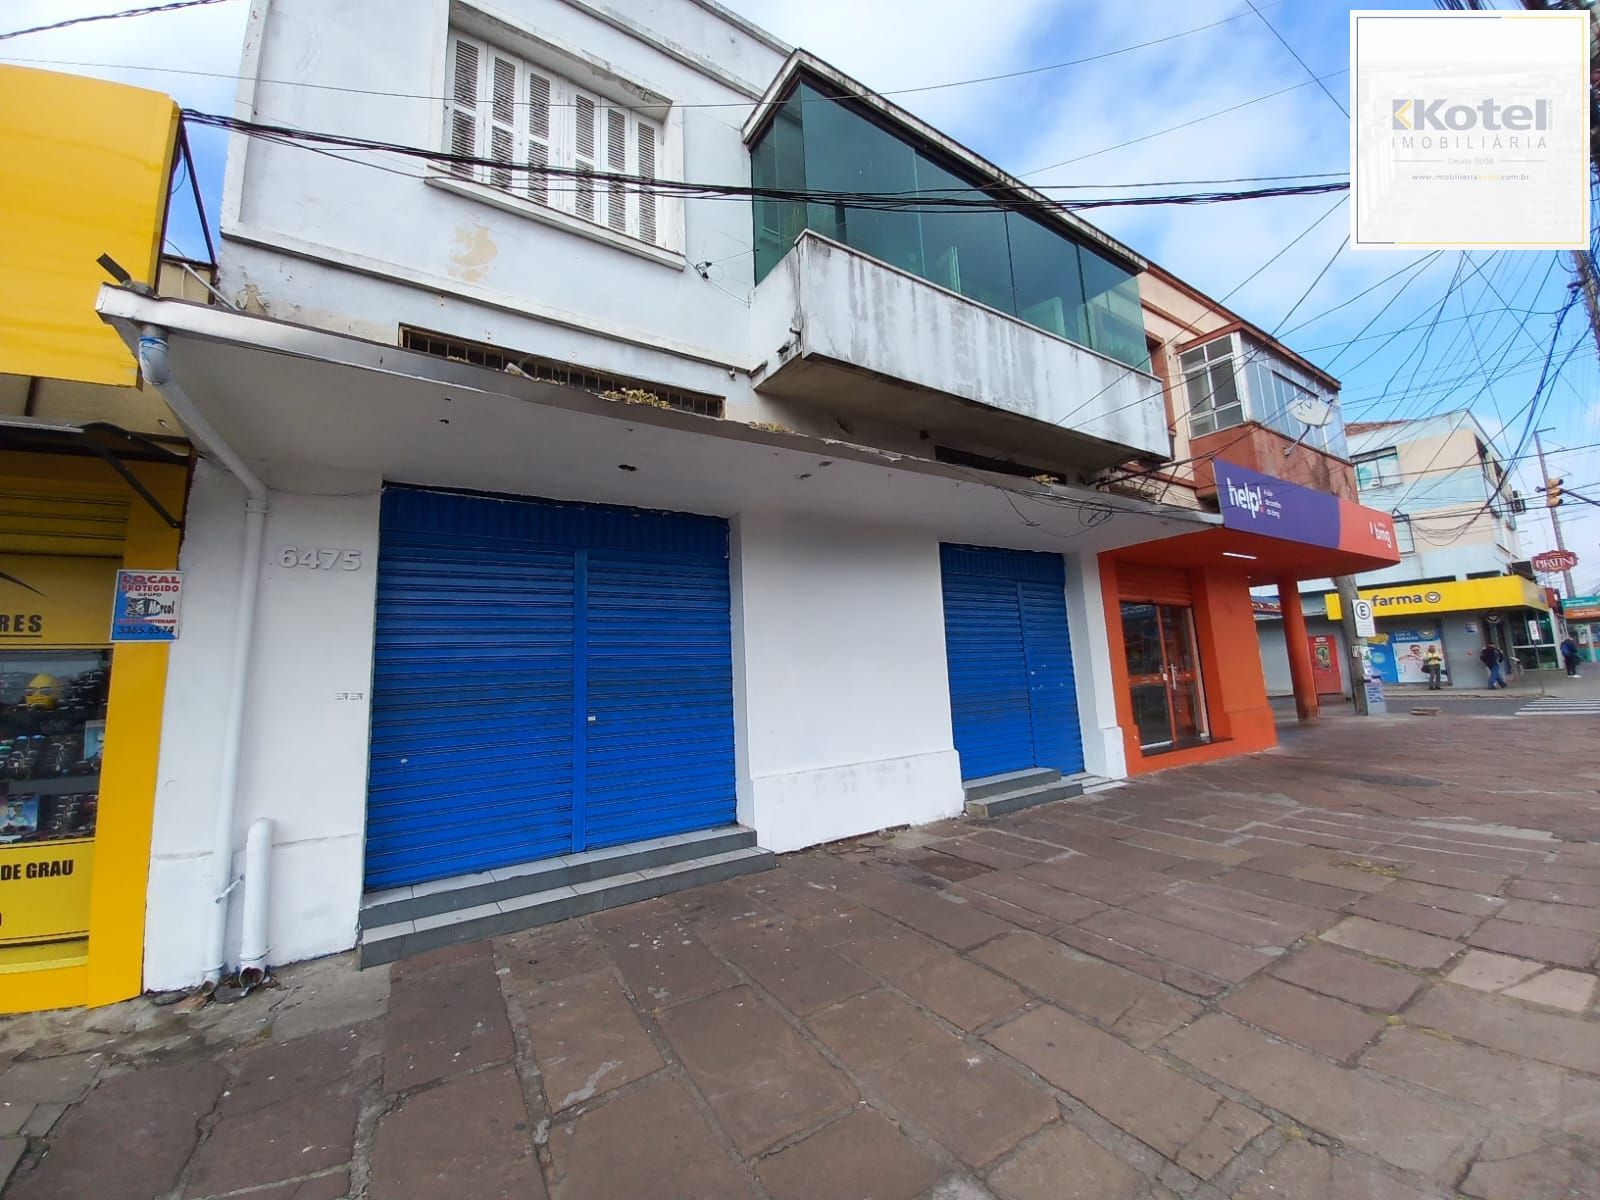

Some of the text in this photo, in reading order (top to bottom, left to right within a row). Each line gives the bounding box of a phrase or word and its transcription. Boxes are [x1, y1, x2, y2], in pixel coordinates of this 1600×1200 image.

[1226, 476, 1265, 519] help!
[277, 546, 362, 572] 6475
[121, 575, 181, 584] LOCAL
[121, 583, 180, 593] PROTEGIDO
[1371, 594, 1423, 607] farma
[1359, 605, 1367, 617] E
[0, 614, 42, 632] RES
[1, 859, 74, 880] DE GRAU
